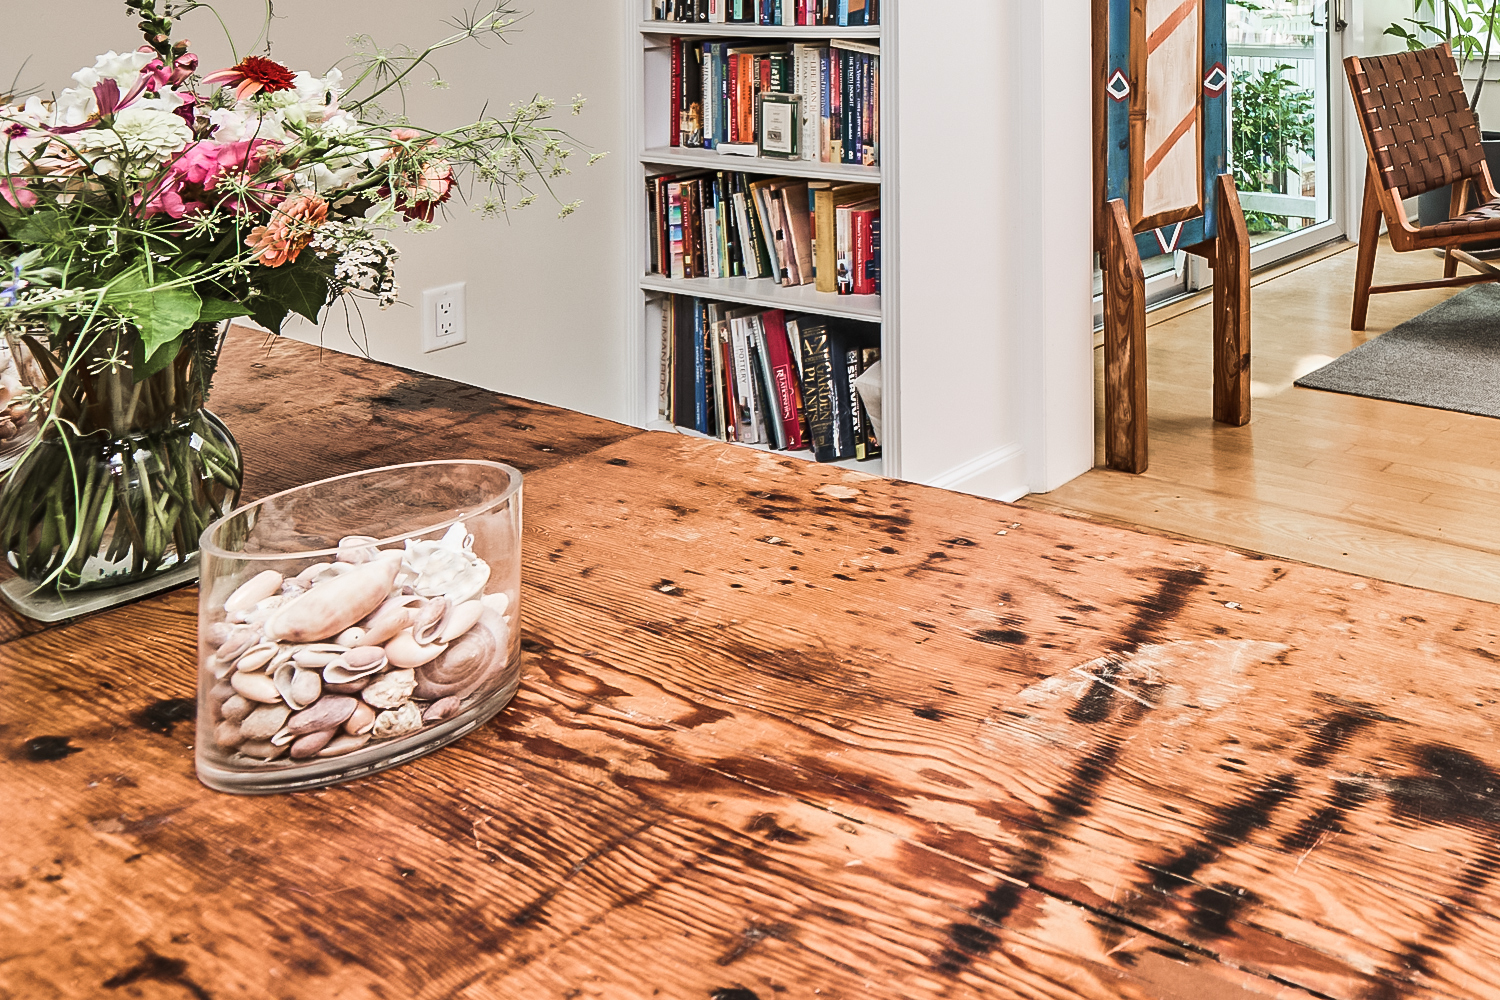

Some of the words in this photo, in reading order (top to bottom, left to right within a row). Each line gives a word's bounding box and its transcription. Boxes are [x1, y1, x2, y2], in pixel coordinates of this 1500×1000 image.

[738, 348, 747, 384] POTTERY
[816, 364, 830, 421] GARDEN
[803, 367, 818, 422] PLANTS
